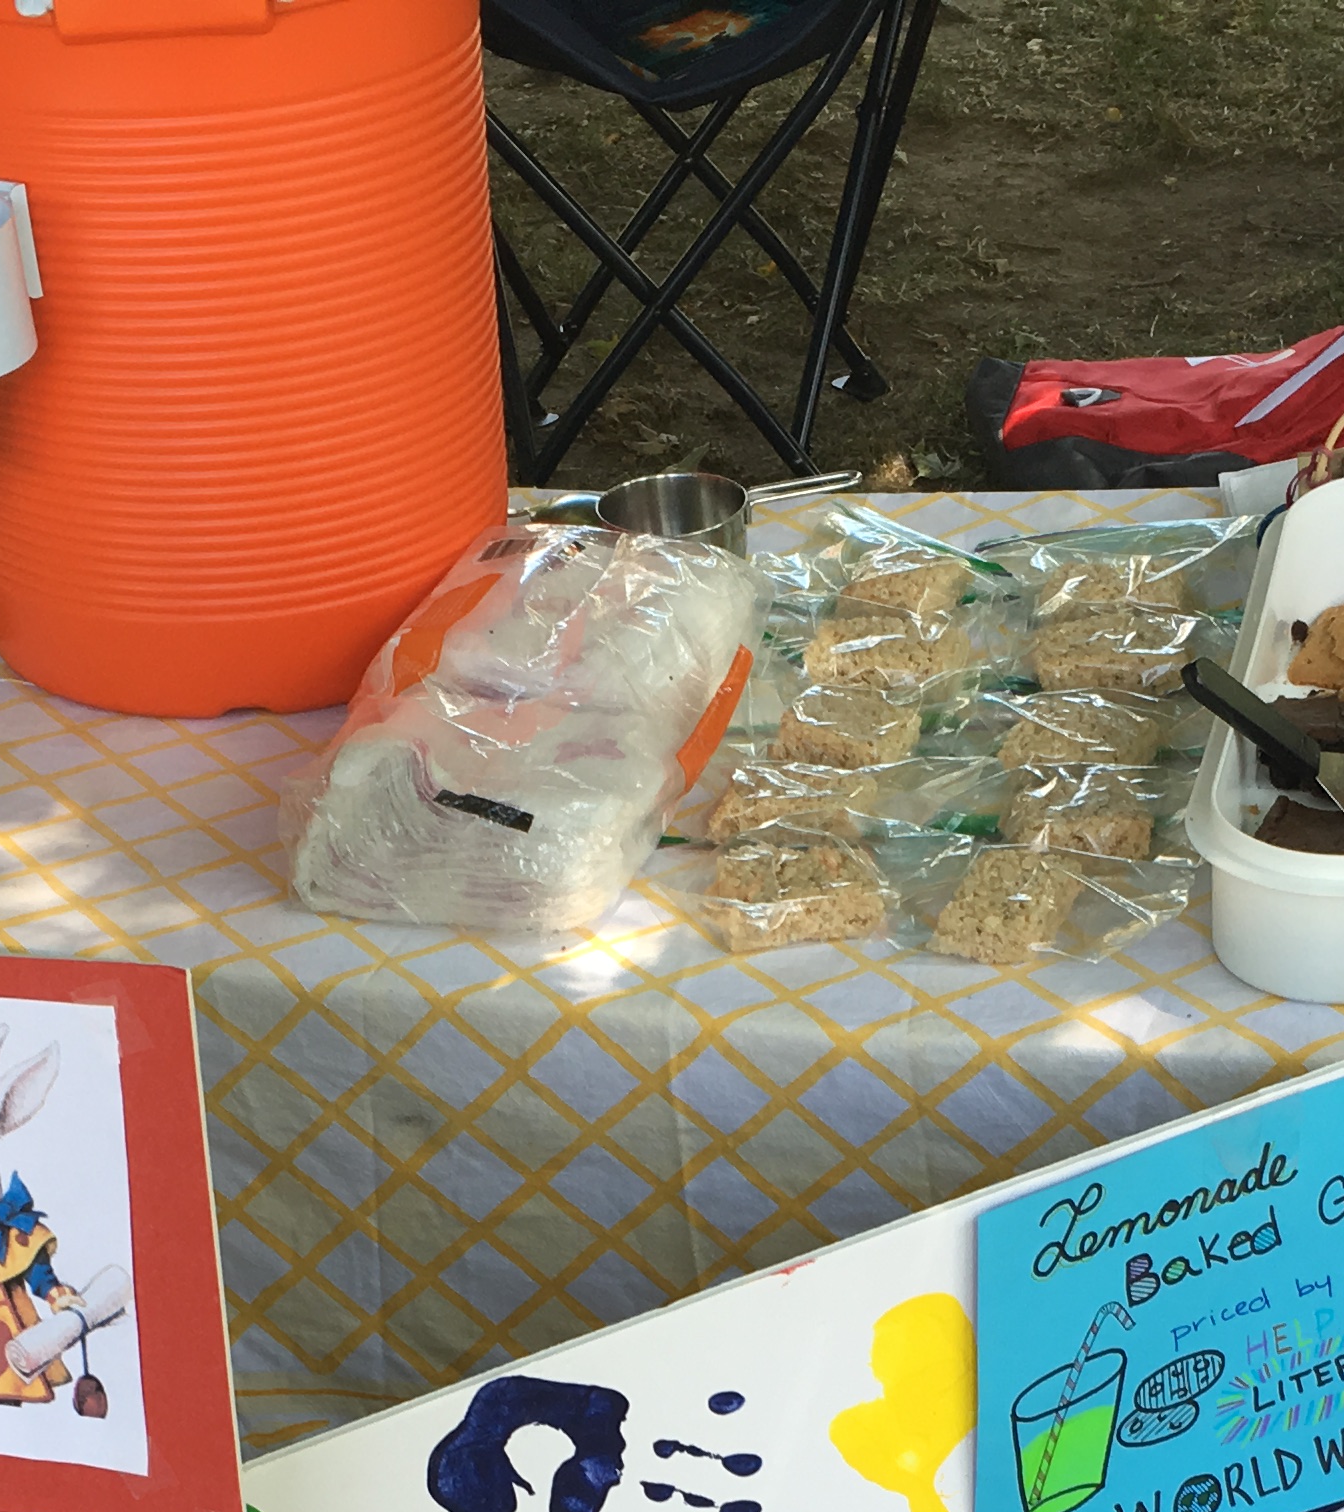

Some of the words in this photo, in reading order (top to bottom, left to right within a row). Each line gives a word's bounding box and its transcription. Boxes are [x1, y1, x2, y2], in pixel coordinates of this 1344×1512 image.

[1031, 1142, 1299, 1283] Lemonade
[1126, 1206, 1282, 1306] Baked
[1171, 1287, 1271, 1350] priced
[1295, 1270, 1334, 1309] by
[1245, 1306, 1335, 1364] HELP
